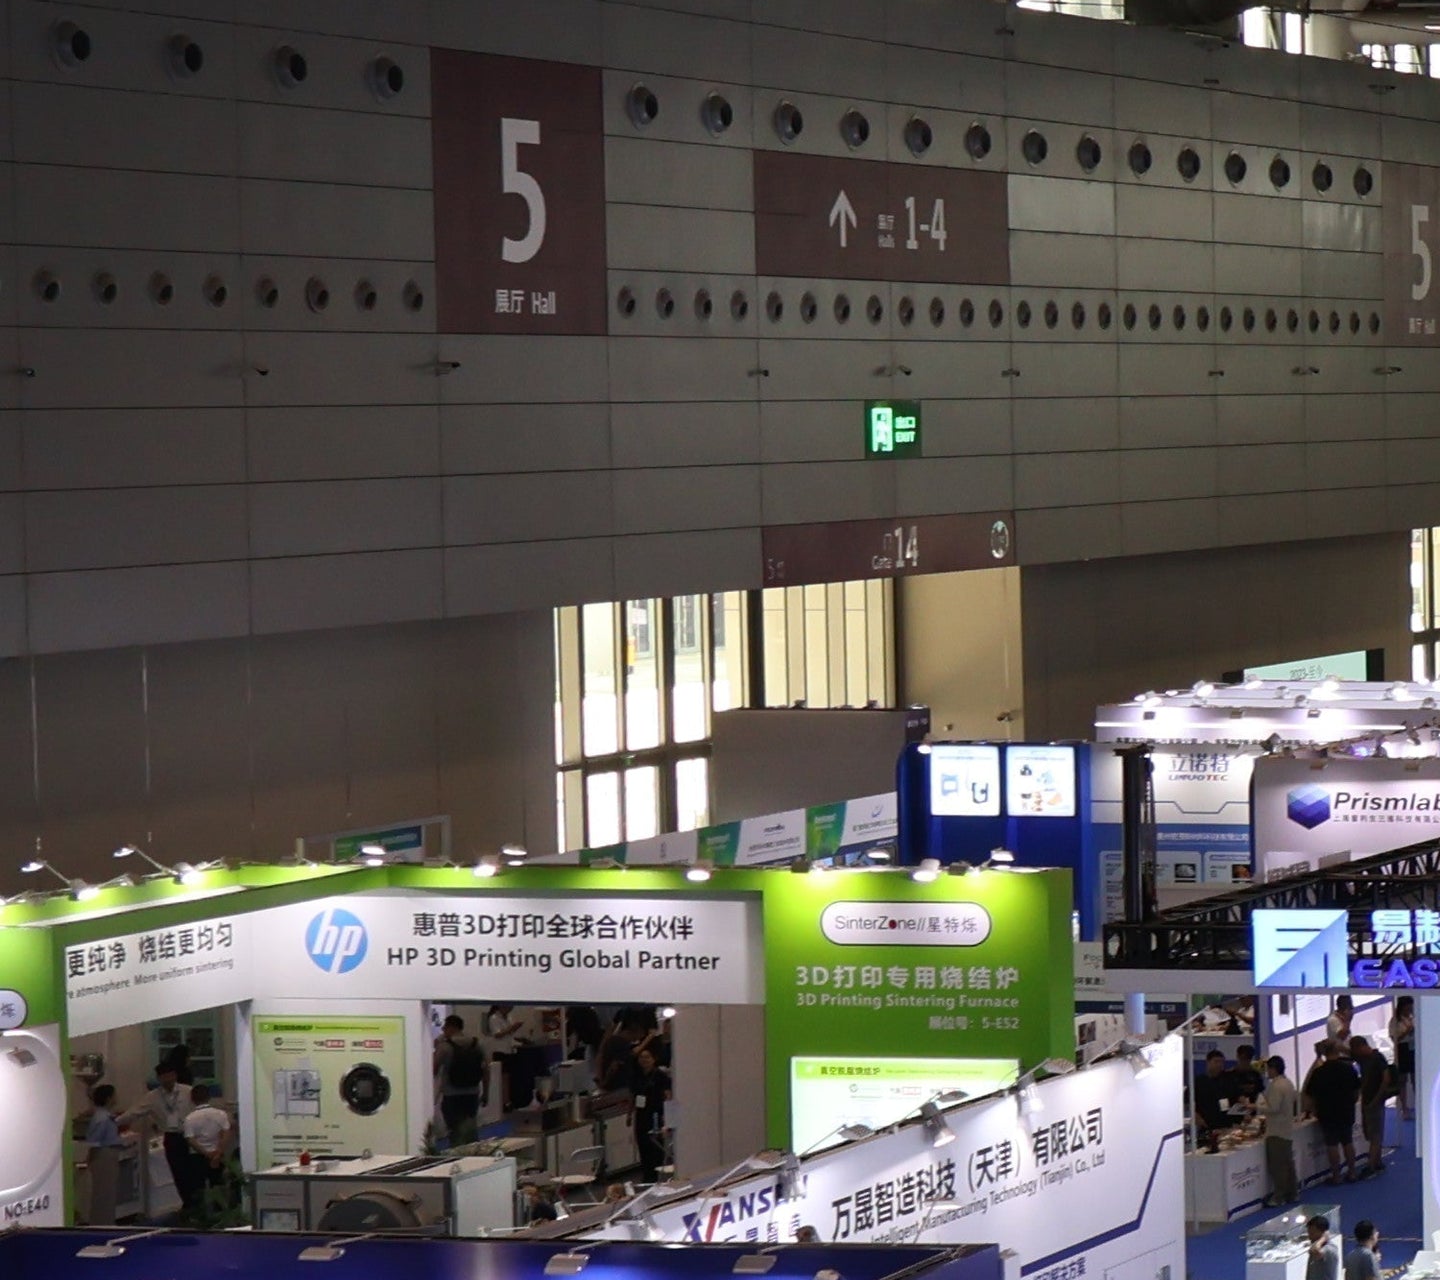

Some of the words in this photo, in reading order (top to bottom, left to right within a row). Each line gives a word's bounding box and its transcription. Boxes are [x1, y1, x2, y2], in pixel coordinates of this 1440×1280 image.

[502, 118, 547, 264] 5
[905, 196, 948, 251] 1-4
[1411, 204, 1432, 301] 5
[496, 289, 524, 314] 展厅
[532, 292, 556, 314] Hall
[894, 527, 920, 570] 14
[413, 912, 695, 941] 惠普3D打印全球合作伙伴
[67, 942, 127, 978] 更纯净
[138, 922, 234, 964] 烧结更均匀
[387, 947, 419, 967] HP
[427, 948, 456, 968] 3D
[464, 949, 552, 974] Printing
[559, 950, 632, 971] Global
[639, 951, 722, 973] Partner
[76, 979, 132, 998] atmosphere
[134, 972, 158, 987] More
[159, 964, 195, 982] uniform
[195, 957, 234, 975] sintering
[796, 965, 1020, 990] 3D打印专用烧结炉
[797, 994, 817, 1007] 3D
[820, 994, 882, 1011] Printing
[886, 994, 957, 1011] Sintering
[959, 995, 1020, 1009] Furnace
[831, 1107, 1104, 1241] 万晟智造科技（天津）有限公司
[989, 1180, 1037, 1209] Technology
